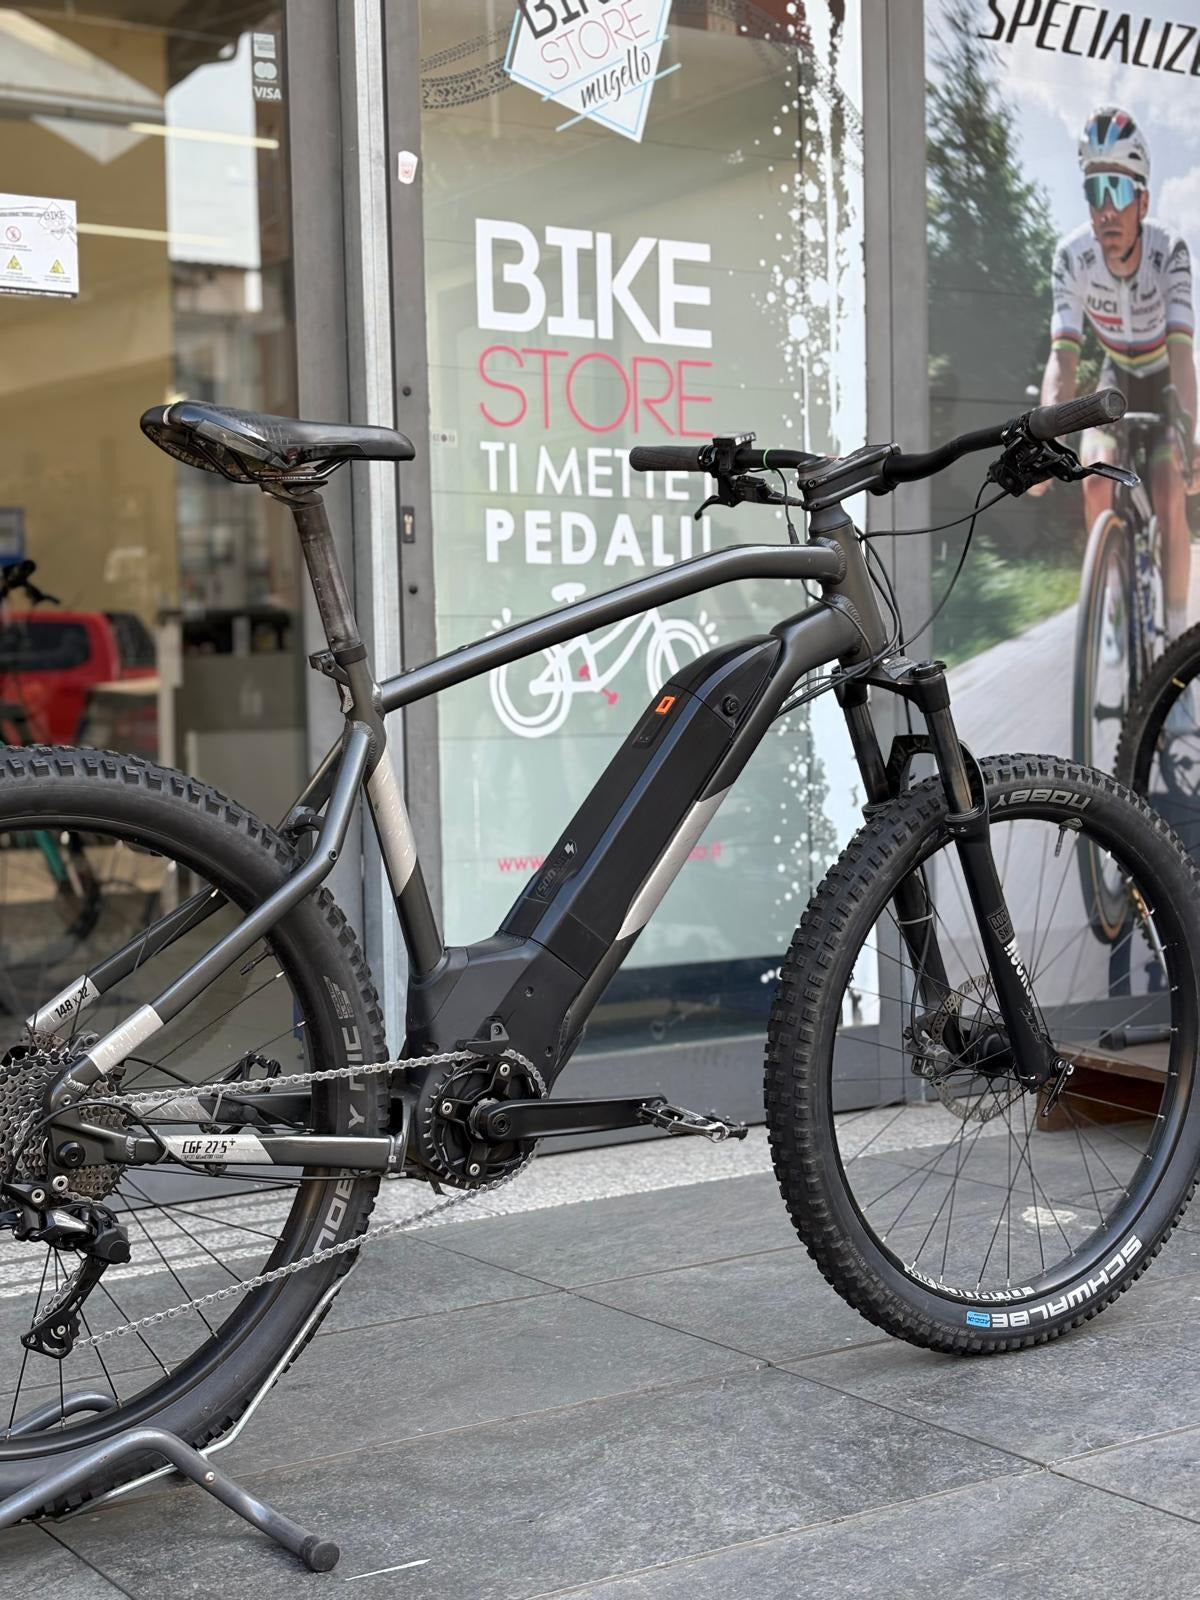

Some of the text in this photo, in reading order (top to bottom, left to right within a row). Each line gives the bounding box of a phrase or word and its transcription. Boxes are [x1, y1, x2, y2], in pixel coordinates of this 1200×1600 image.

[541, 0, 651, 80] STORE
[977, 0, 1200, 77] SPECIALIZ
[253, 86, 282, 100] VISA
[580, 45, 651, 108] mugello
[475, 218, 712, 348] BIKE
[479, 344, 714, 438] STORE
[479, 441, 518, 493] TI
[991, 788, 1092, 811] NOBBY
[55, 999, 74, 1018] 148
[182, 1140, 203, 1154] CGF
[991, 1234, 1143, 1329] SCHWALBE
